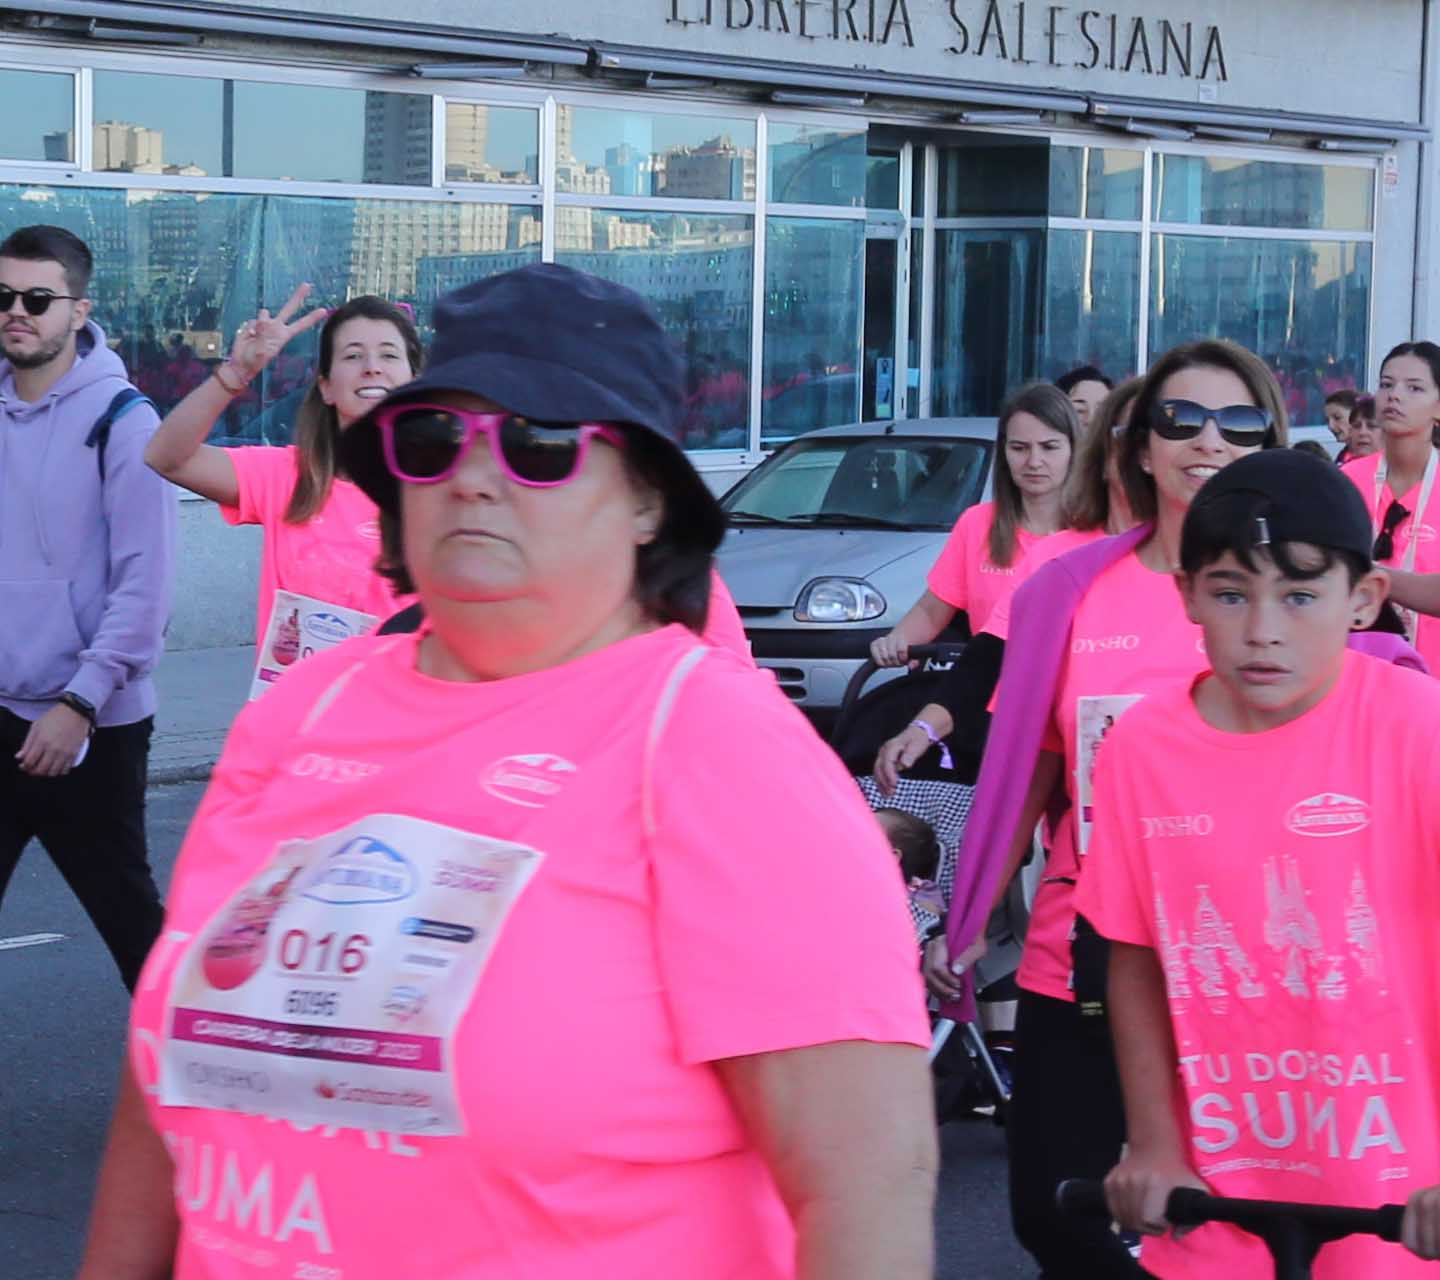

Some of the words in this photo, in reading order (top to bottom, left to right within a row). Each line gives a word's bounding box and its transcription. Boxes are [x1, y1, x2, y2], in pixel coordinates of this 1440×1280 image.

[280, 928, 374, 974] 016
[1179, 1053, 1231, 1087] TU
[1190, 1091, 1408, 1160] SUMA
